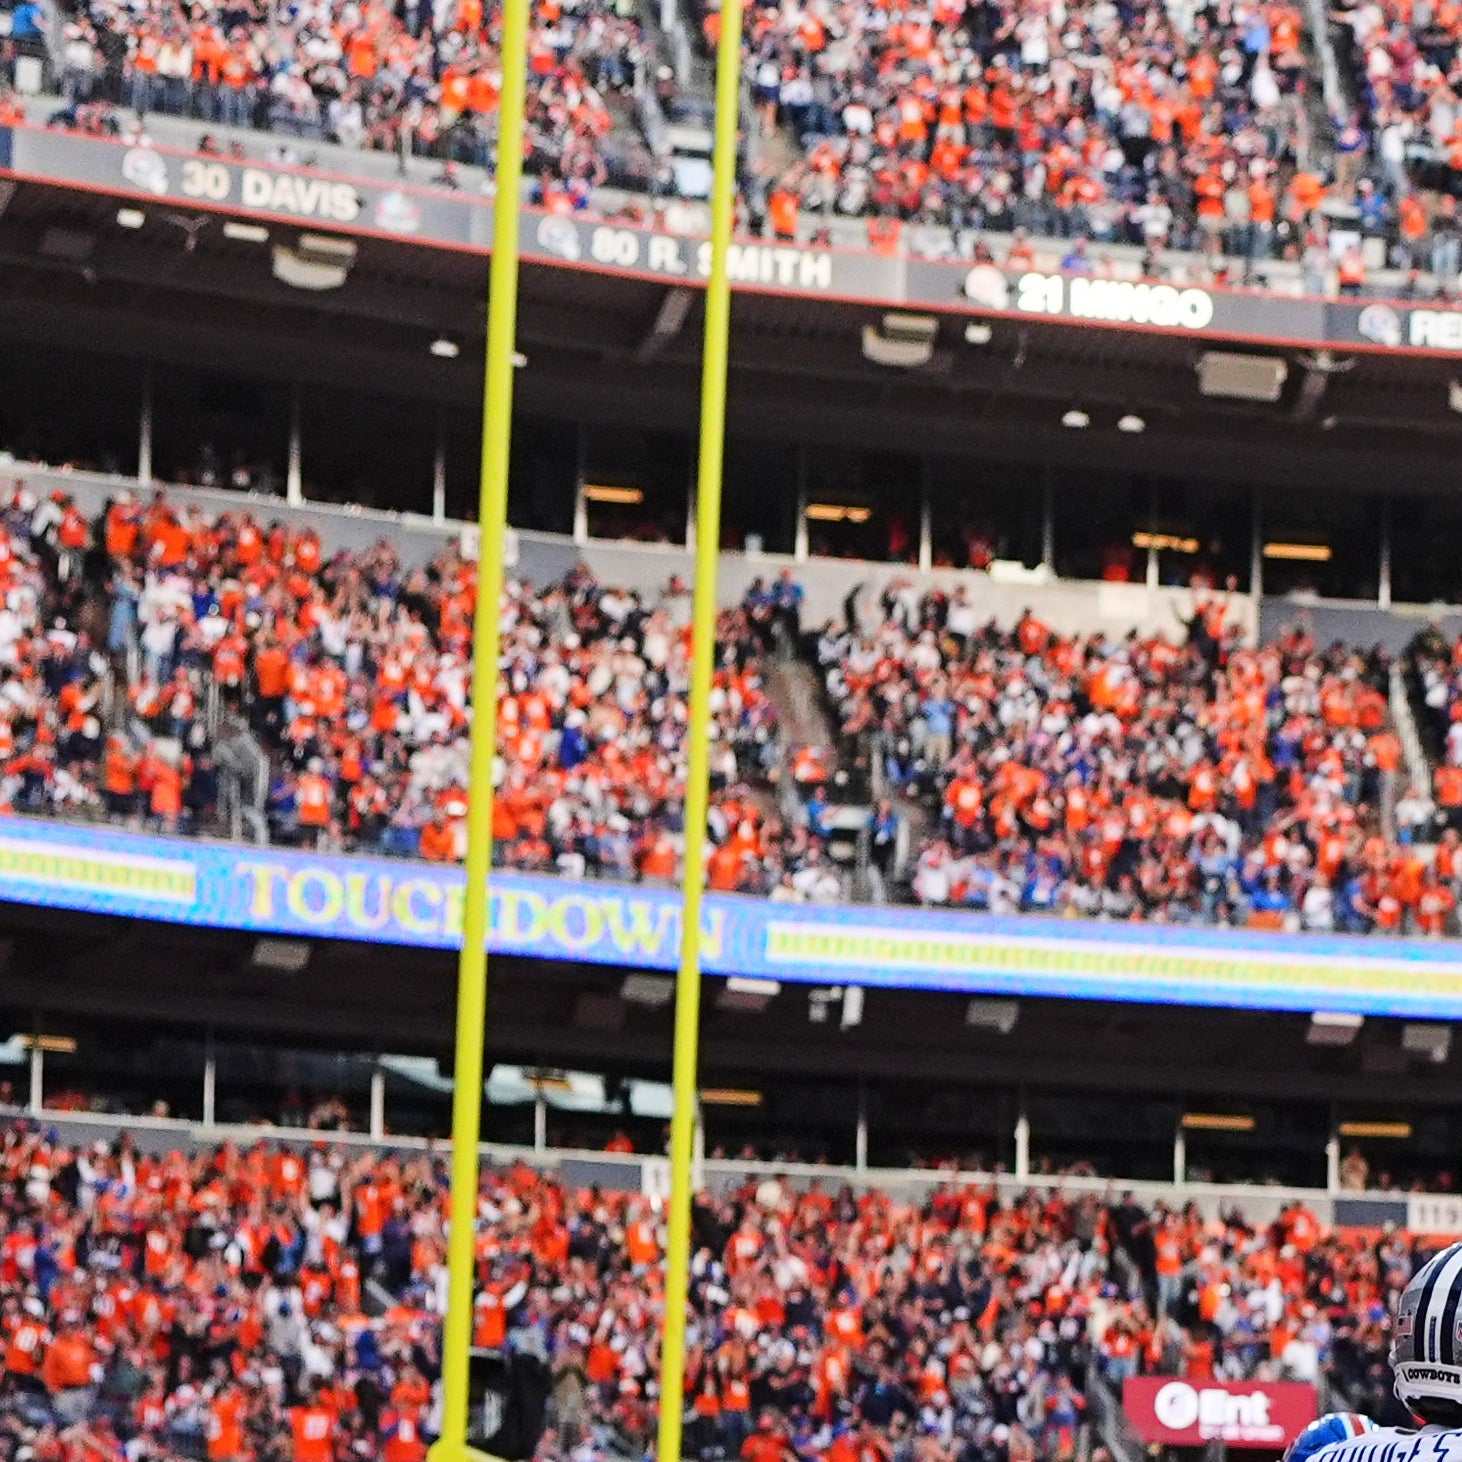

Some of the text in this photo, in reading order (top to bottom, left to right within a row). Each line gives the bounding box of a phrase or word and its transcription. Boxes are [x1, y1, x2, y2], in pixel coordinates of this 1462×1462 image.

[183, 161, 359, 221] 30 DAVIS
[1017, 272, 1063, 314] 21
[1408, 1368, 1460, 1385] COWBOYS
